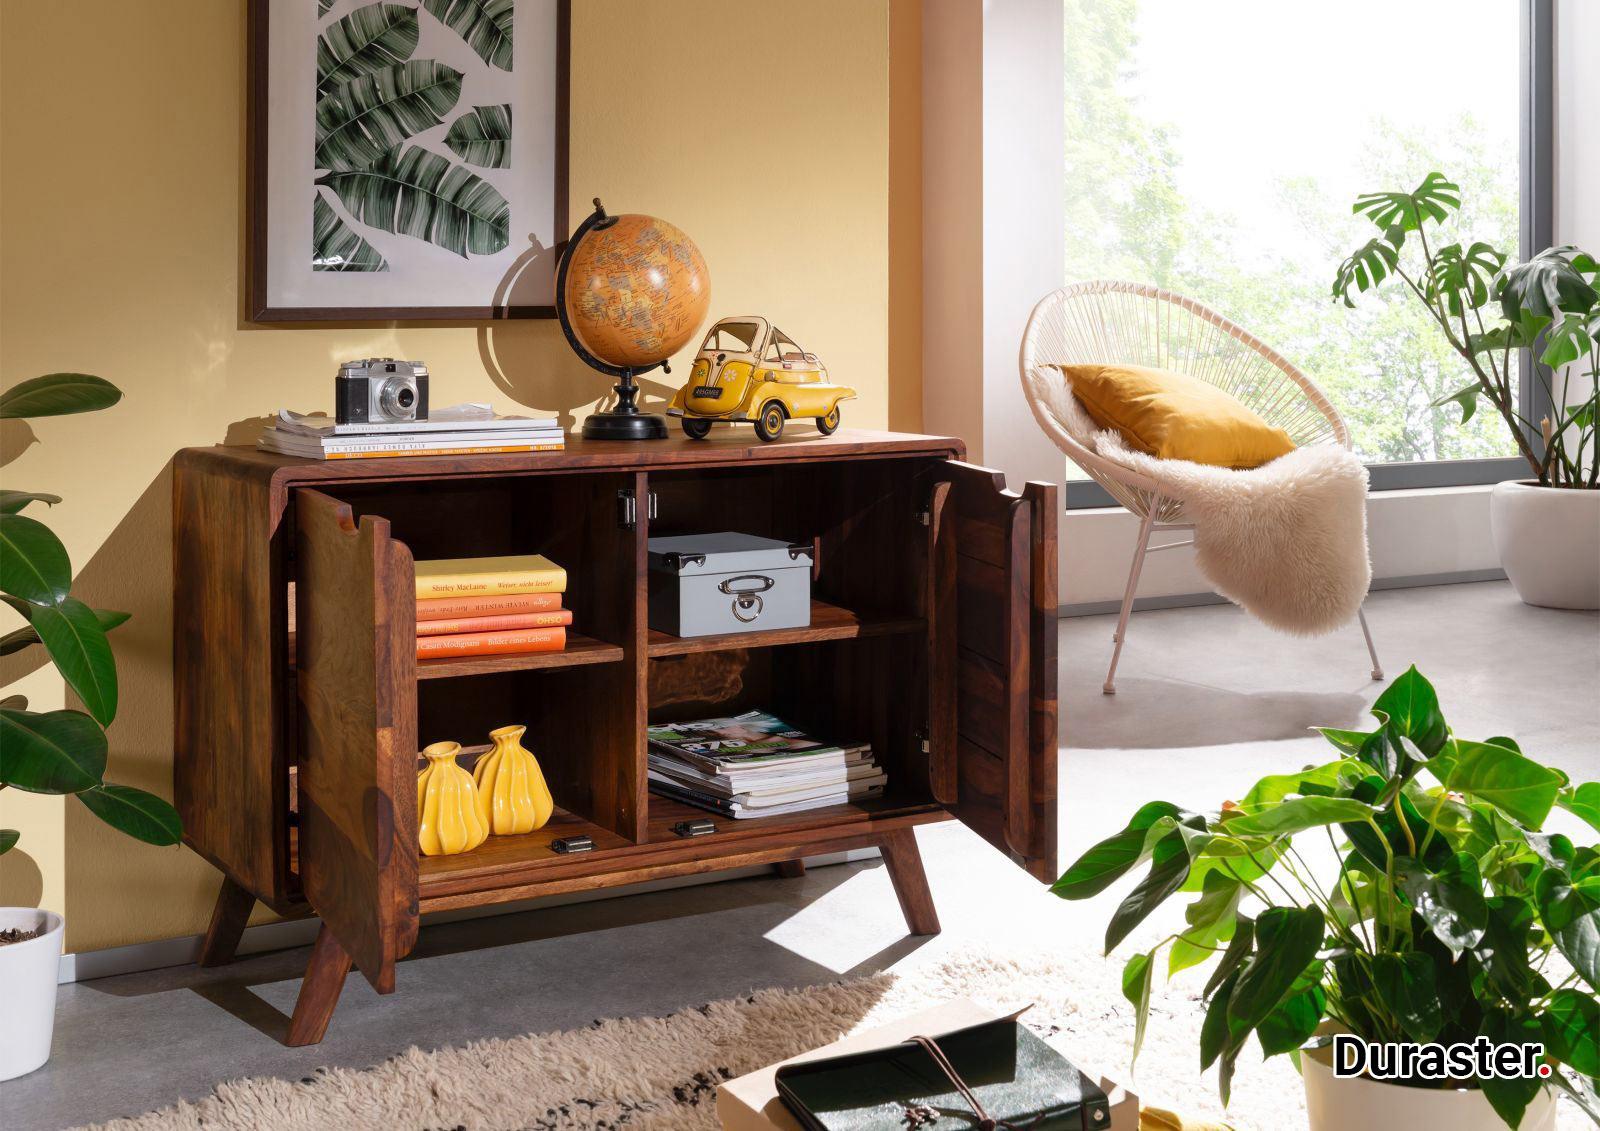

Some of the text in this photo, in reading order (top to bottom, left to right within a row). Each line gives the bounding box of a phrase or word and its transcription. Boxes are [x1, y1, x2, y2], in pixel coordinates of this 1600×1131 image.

[431, 583, 488, 592] Shirley MacLaine
[475, 603, 504, 611] WINTER
[536, 615, 563, 624] OSHO
[487, 638, 508, 646] Bilder
